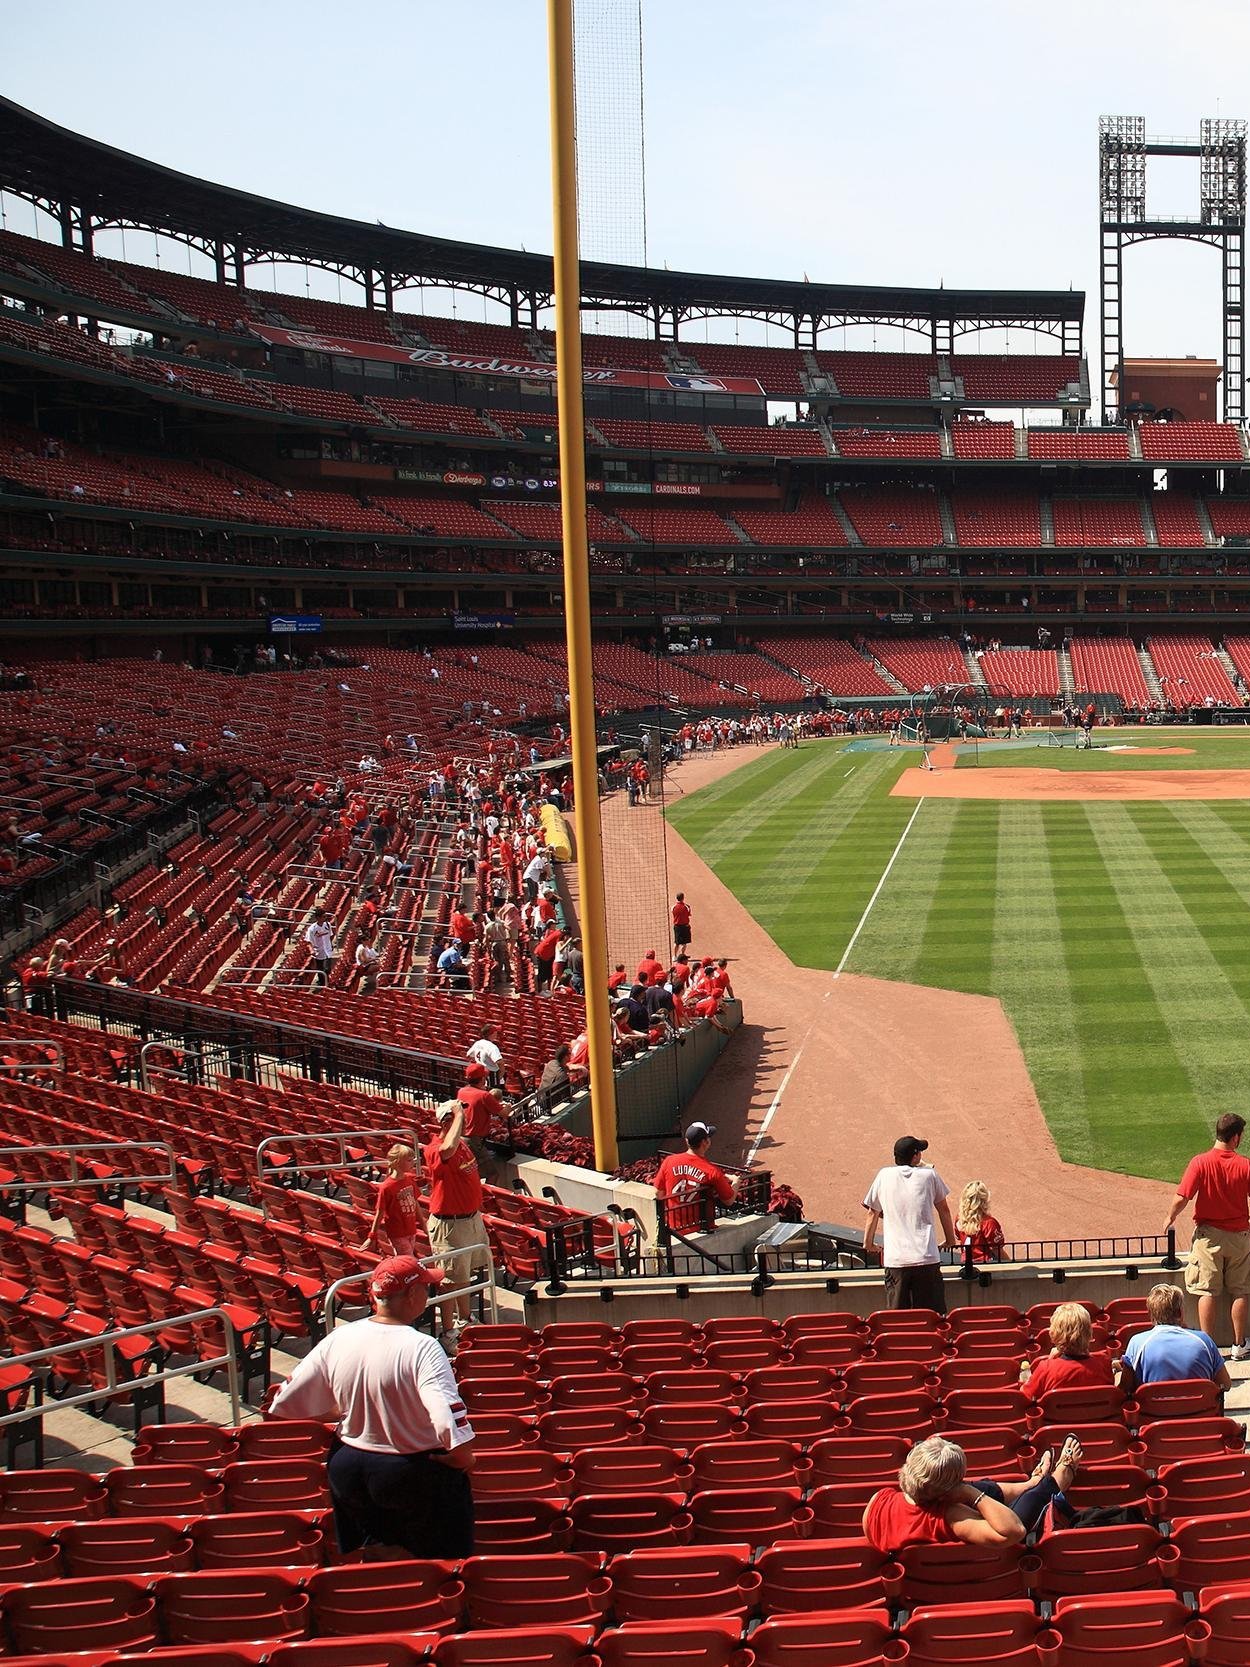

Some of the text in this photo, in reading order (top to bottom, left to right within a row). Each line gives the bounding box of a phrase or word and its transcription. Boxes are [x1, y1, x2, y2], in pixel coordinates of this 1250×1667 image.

[409, 350, 615, 380] Budweer
[655, 485, 700, 494] CARDINALS.COM
[672, 1164, 706, 1181] LUDWICK
